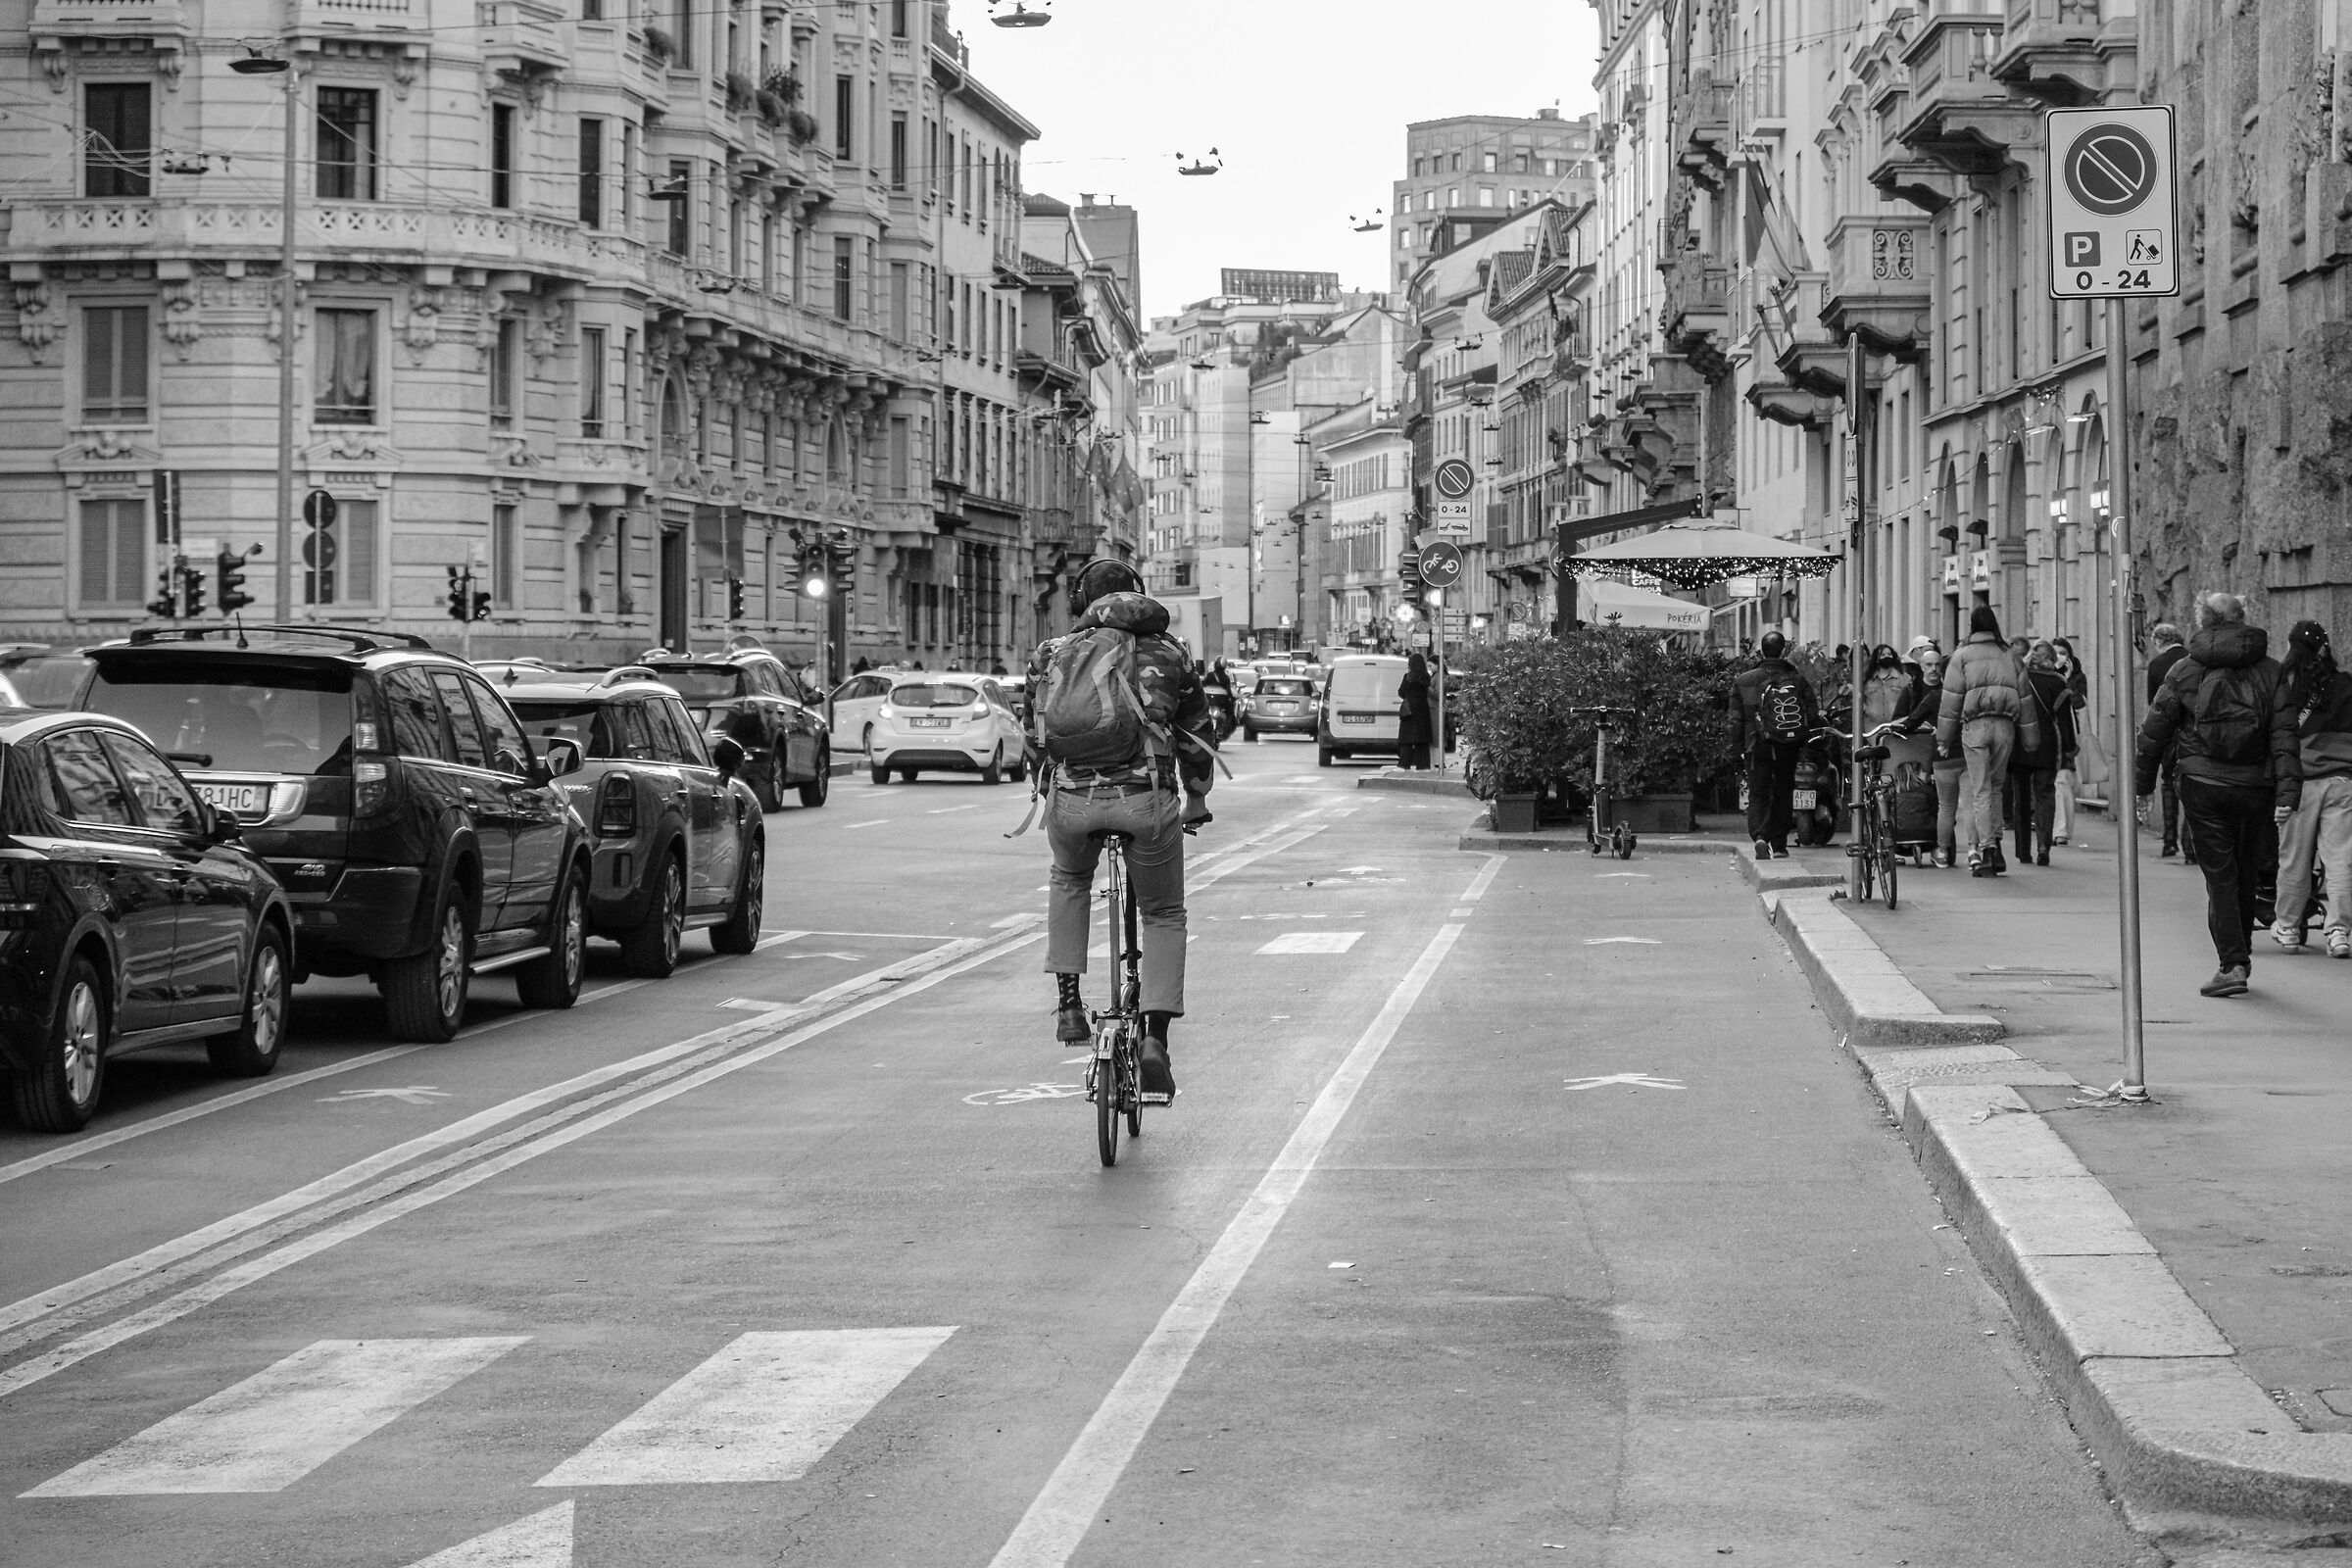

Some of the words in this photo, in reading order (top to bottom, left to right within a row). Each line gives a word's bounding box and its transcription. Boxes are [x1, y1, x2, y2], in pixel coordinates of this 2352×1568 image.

[2072, 235, 2093, 264] P
[2076, 270, 2093, 291] 0
[2117, 270, 2151, 290] 24
[1667, 612, 1702, 624] POKÉRIA
